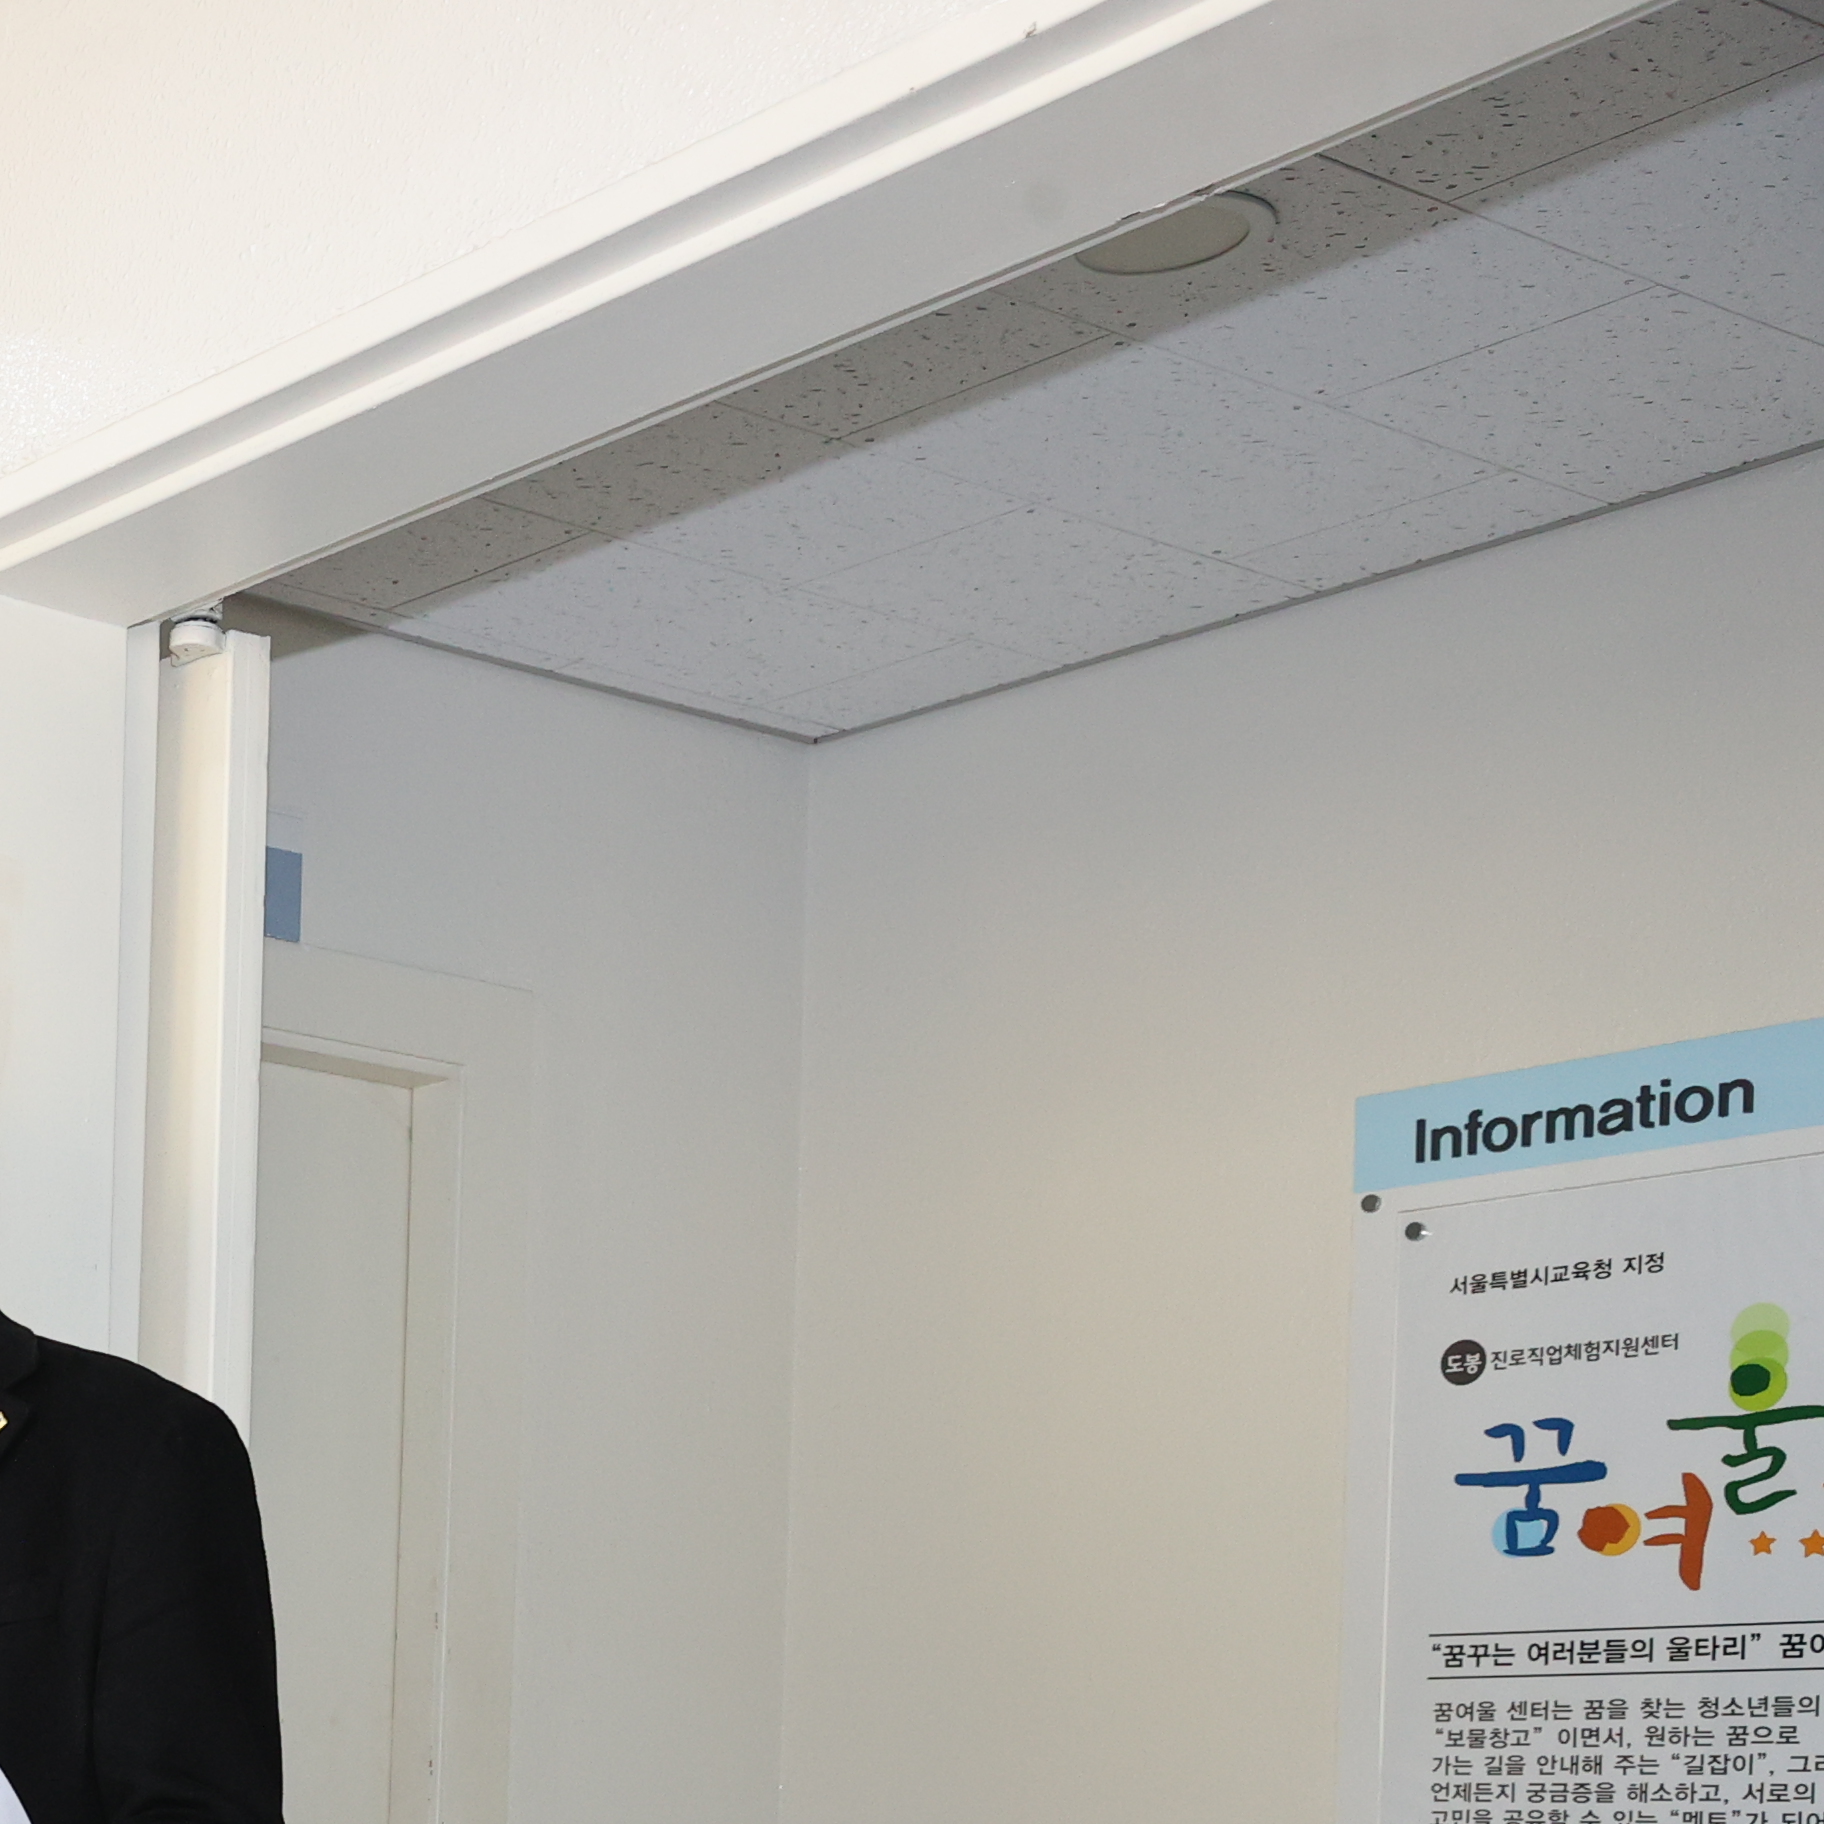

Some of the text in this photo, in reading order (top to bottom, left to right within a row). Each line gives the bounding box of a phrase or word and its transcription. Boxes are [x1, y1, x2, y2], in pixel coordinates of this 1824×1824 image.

[1415, 1079, 1754, 1162] Information
[1450, 1252, 1665, 1294] 서울특별시교육청 지정
[1446, 1334, 1679, 1374] 도봉 진로직업체험지원센터
[1527, 1637, 1653, 1666] 여러분들의
[1433, 1695, 1820, 1722] 꿈여울 센터는 꿈을 찾는 청소년들의
[1557, 1726, 1631, 1749] 이면서,
[1644, 1725, 1715, 1747] 원하는
[1726, 1725, 1800, 1747] 꿈으로
[1432, 1755, 1473, 1776] 가는
[1484, 1755, 1526, 1776] 길을
[1536, 1754, 1603, 1776] 안내해
[1614, 1754, 1660, 1776] 주는
[1430, 1782, 1815, 1805] 언제든지 궁금증을 해소하고, 서로의
